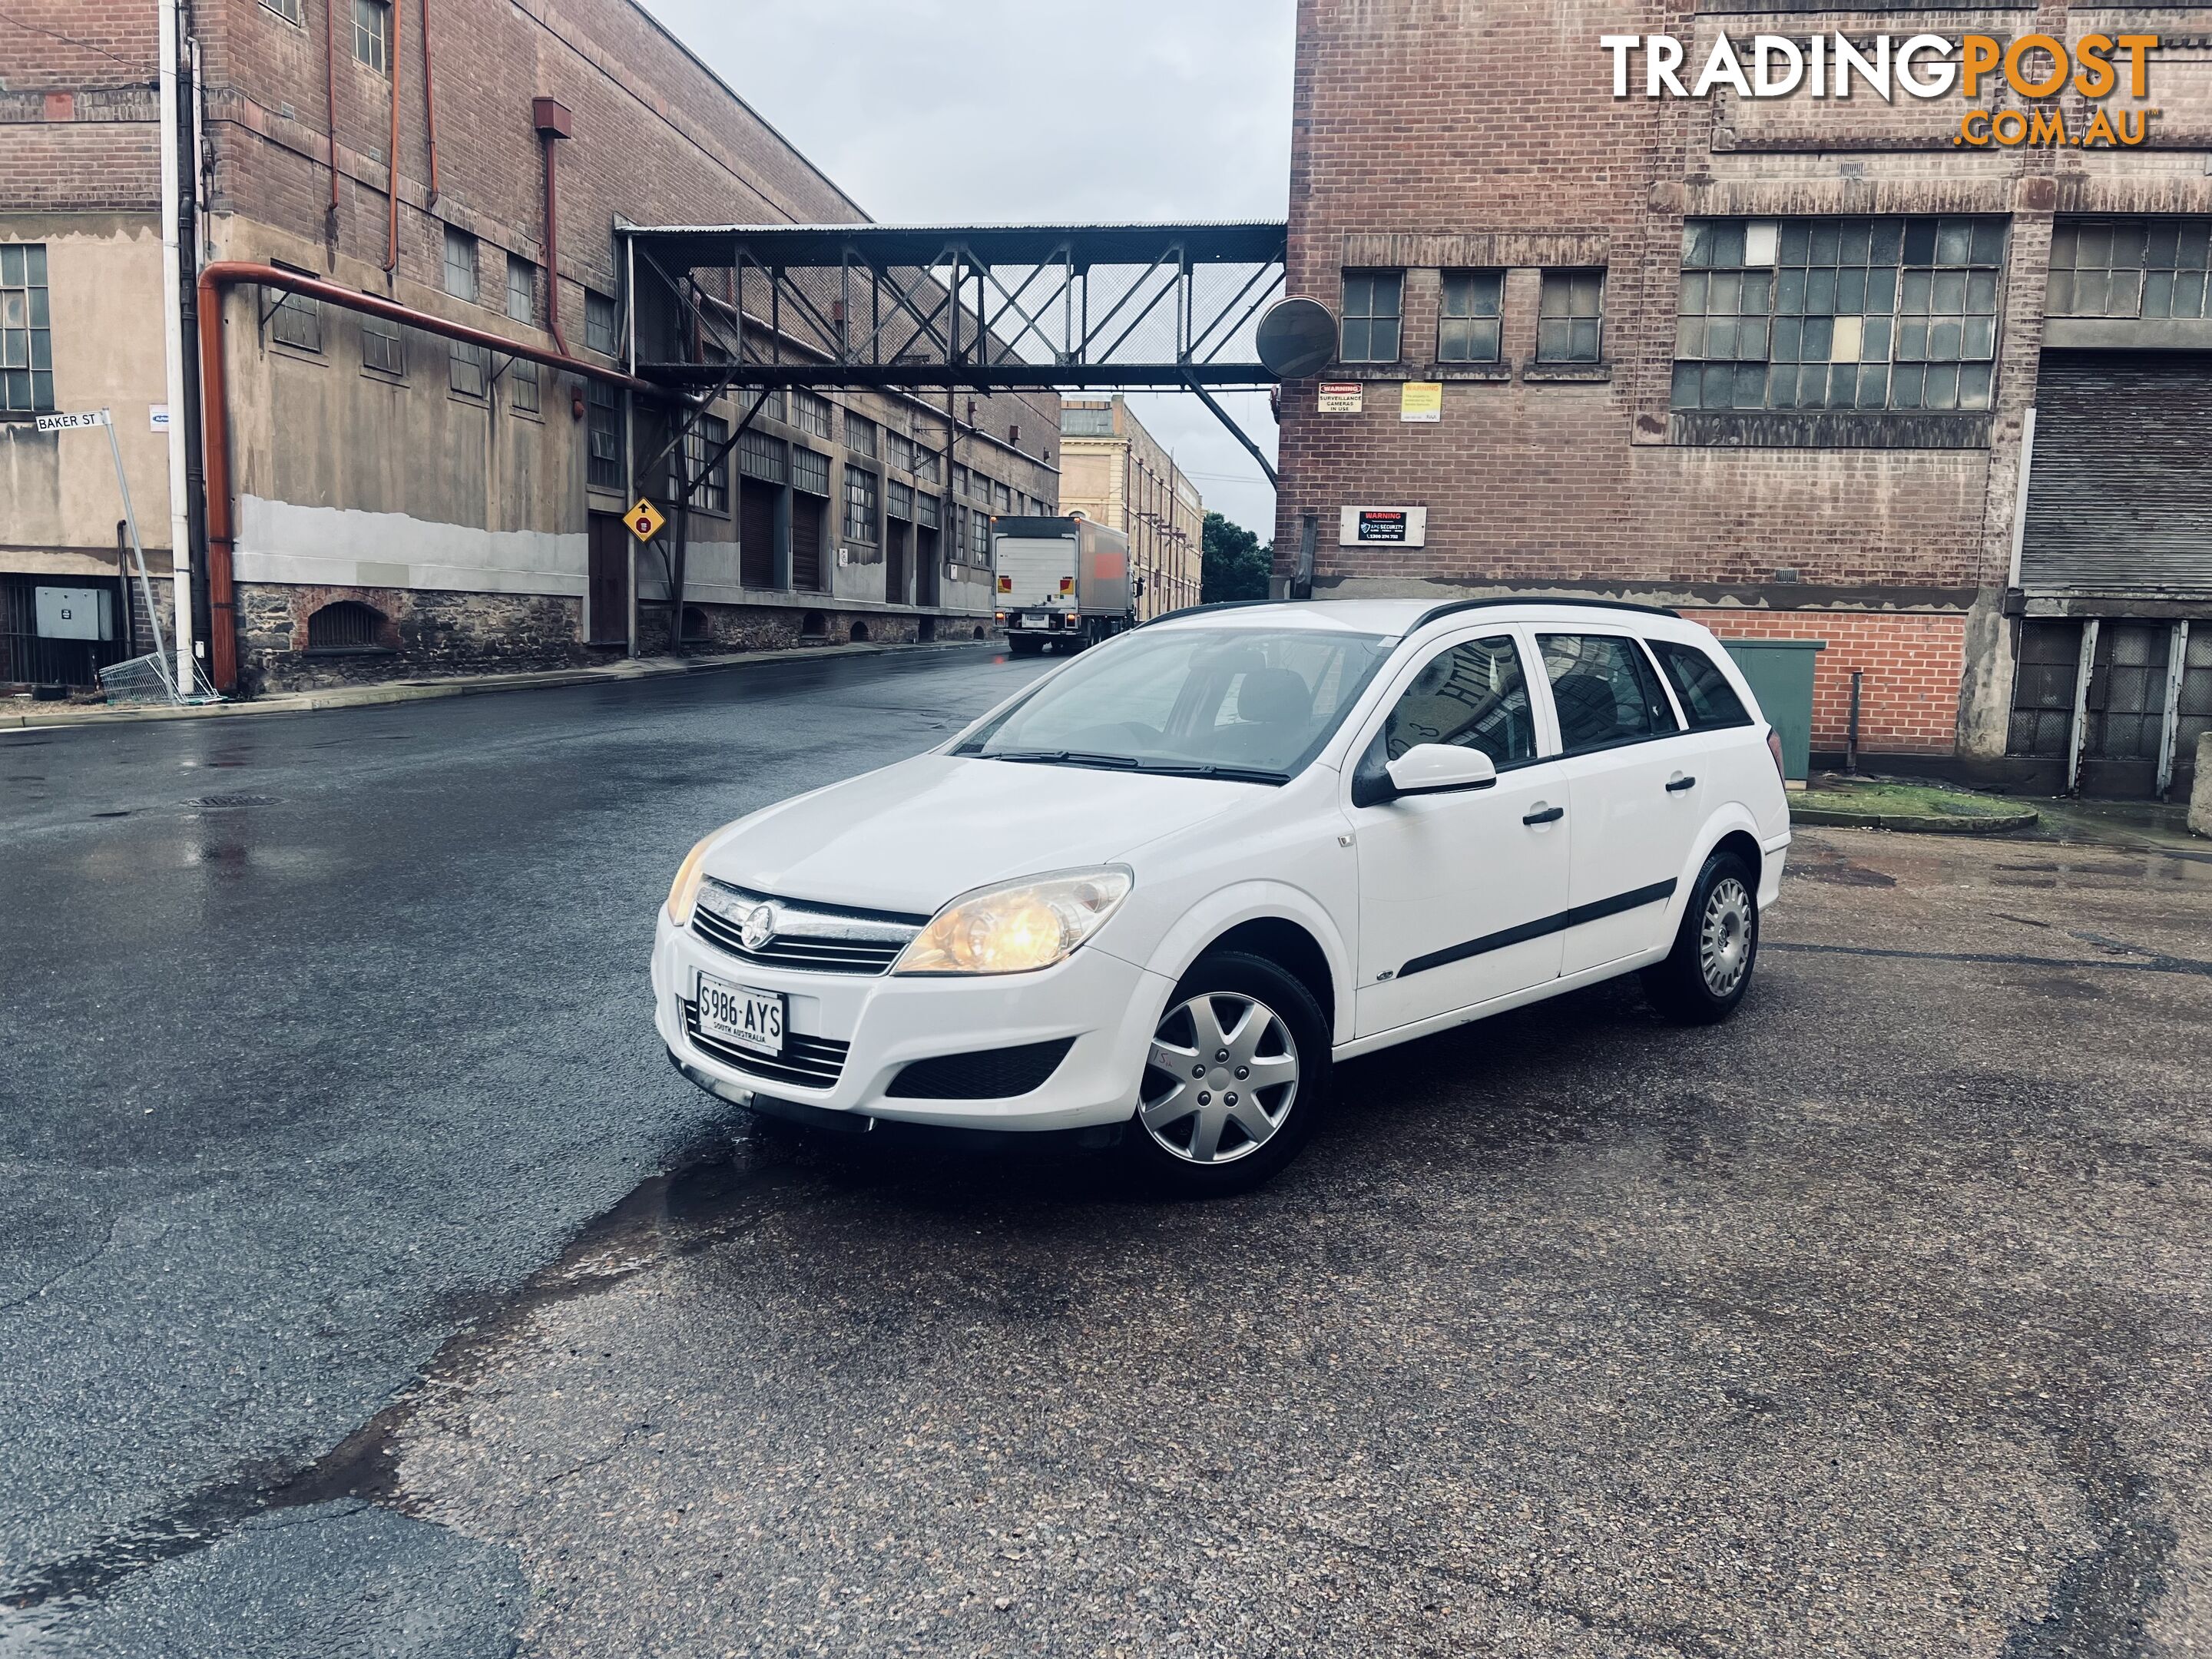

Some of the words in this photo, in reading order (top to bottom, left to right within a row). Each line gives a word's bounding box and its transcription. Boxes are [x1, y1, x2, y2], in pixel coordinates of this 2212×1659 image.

[38, 416, 78, 429] BAKER
[82, 413, 95, 425] ST
[714, 1022, 732, 1034] SOUTH
[733, 1028, 767, 1044] AUSTRALIA
